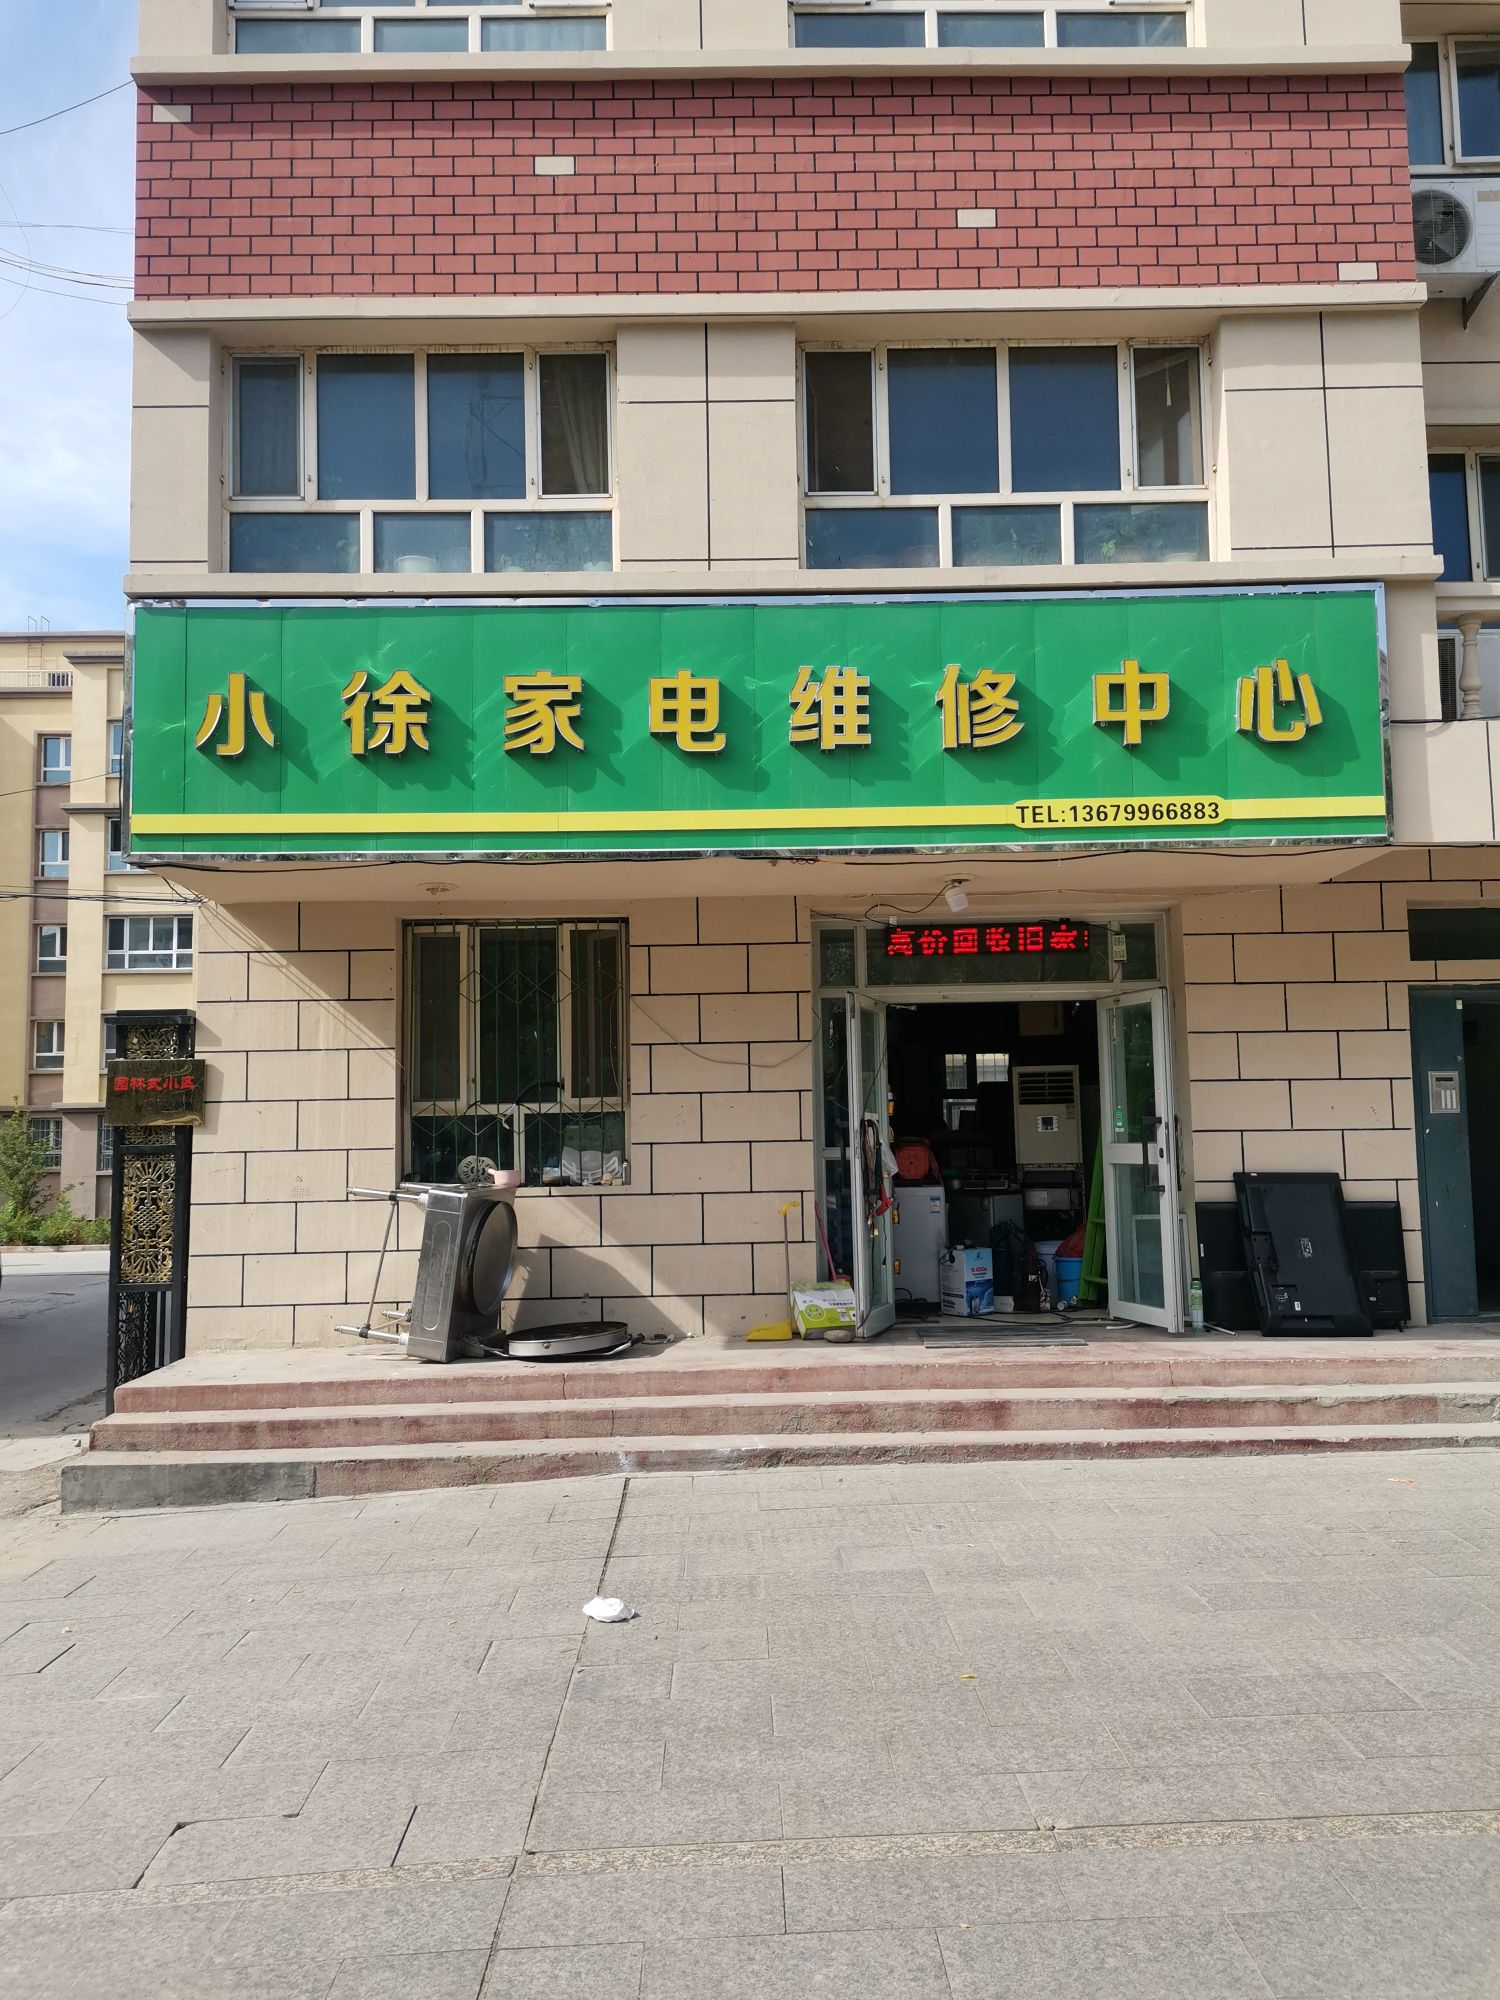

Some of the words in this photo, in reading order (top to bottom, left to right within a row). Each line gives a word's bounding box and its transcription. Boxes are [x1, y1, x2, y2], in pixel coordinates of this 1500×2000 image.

[195, 658, 1323, 757] 小徐家电维修中心
[1016, 802, 1220, 824] TEL:13679966883
[887, 924, 1088, 956] 高价回收旧家
